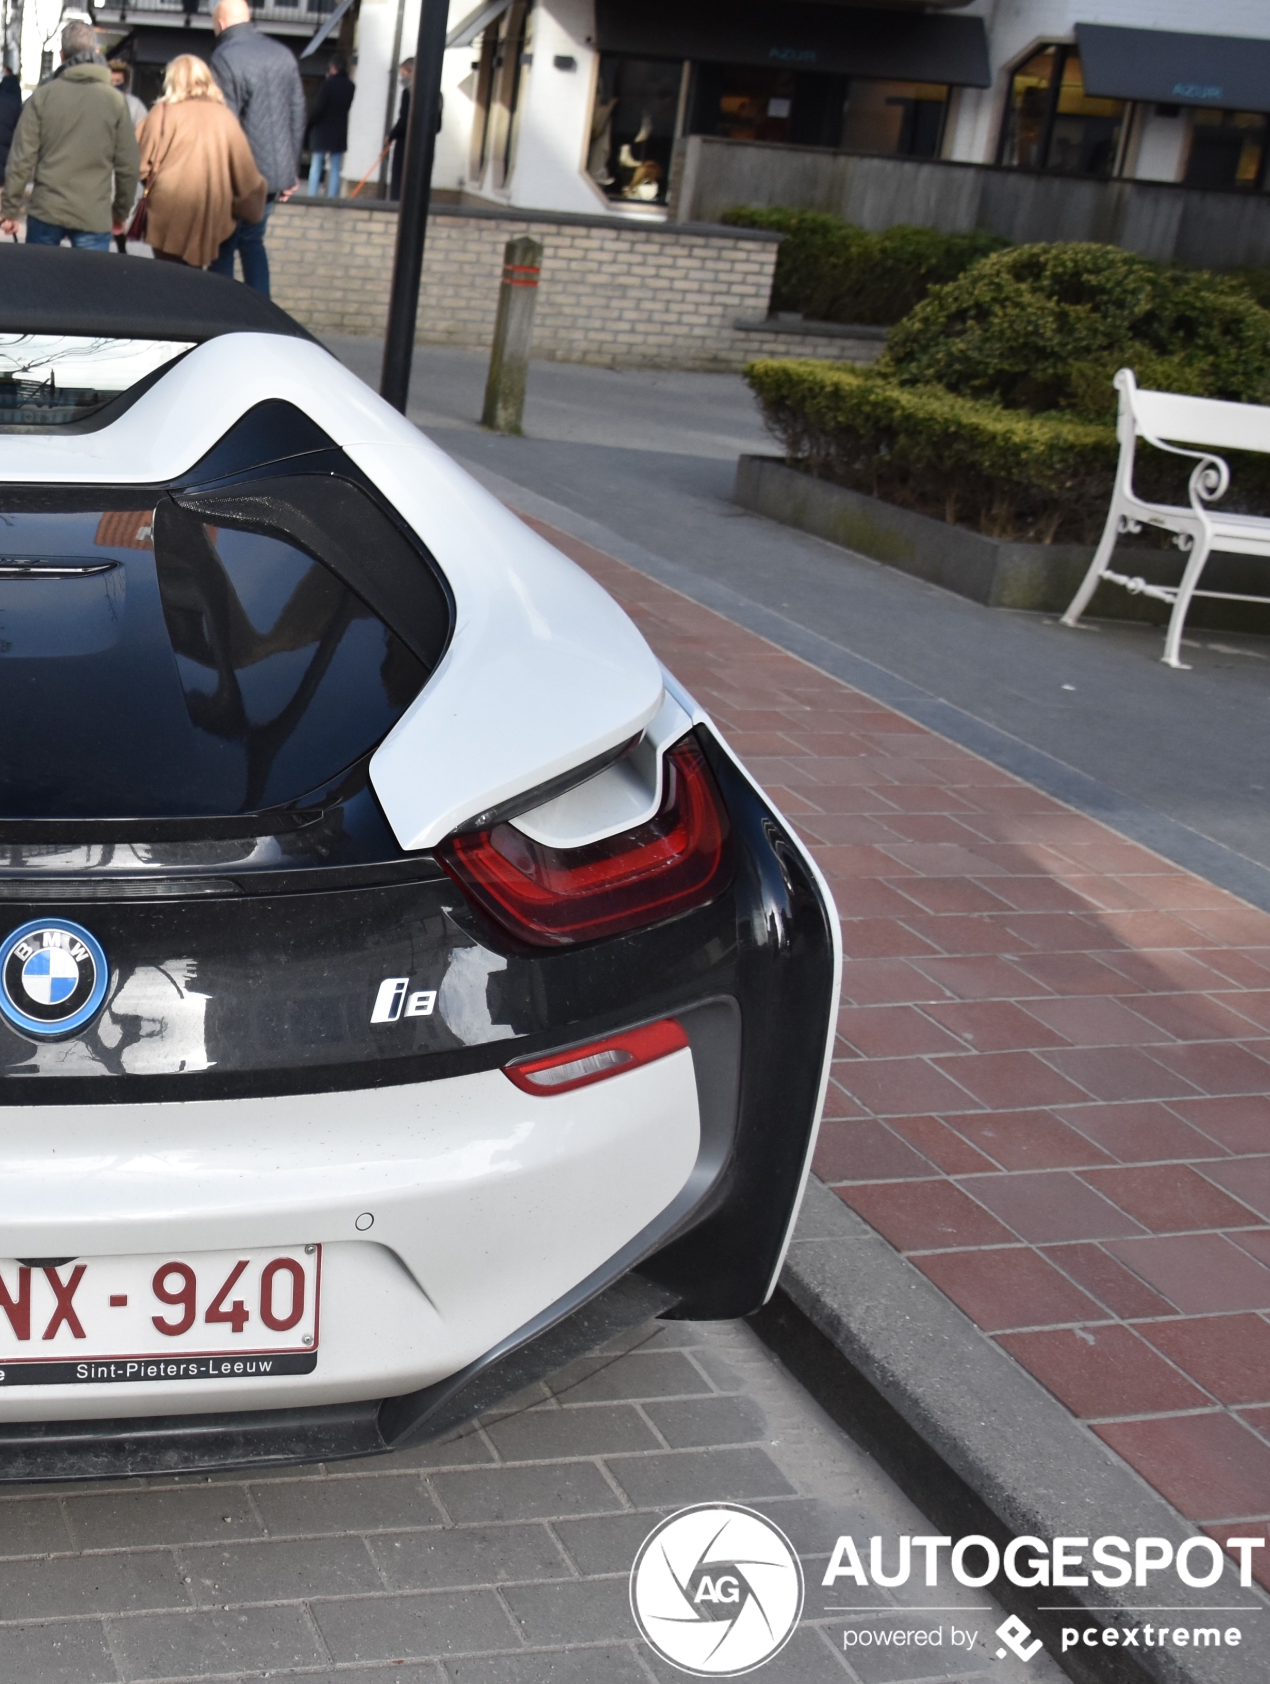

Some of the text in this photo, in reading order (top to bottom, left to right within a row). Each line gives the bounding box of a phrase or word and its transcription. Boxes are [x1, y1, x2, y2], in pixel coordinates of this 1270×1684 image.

[768, 47, 817, 62] AZUR
[1172, 83, 1223, 99] AZUR
[13, 931, 90, 963] BMW
[370, 977, 438, 1024] i8
[76, 1360, 273, 1379] Sint-Pieters-Leeuw
